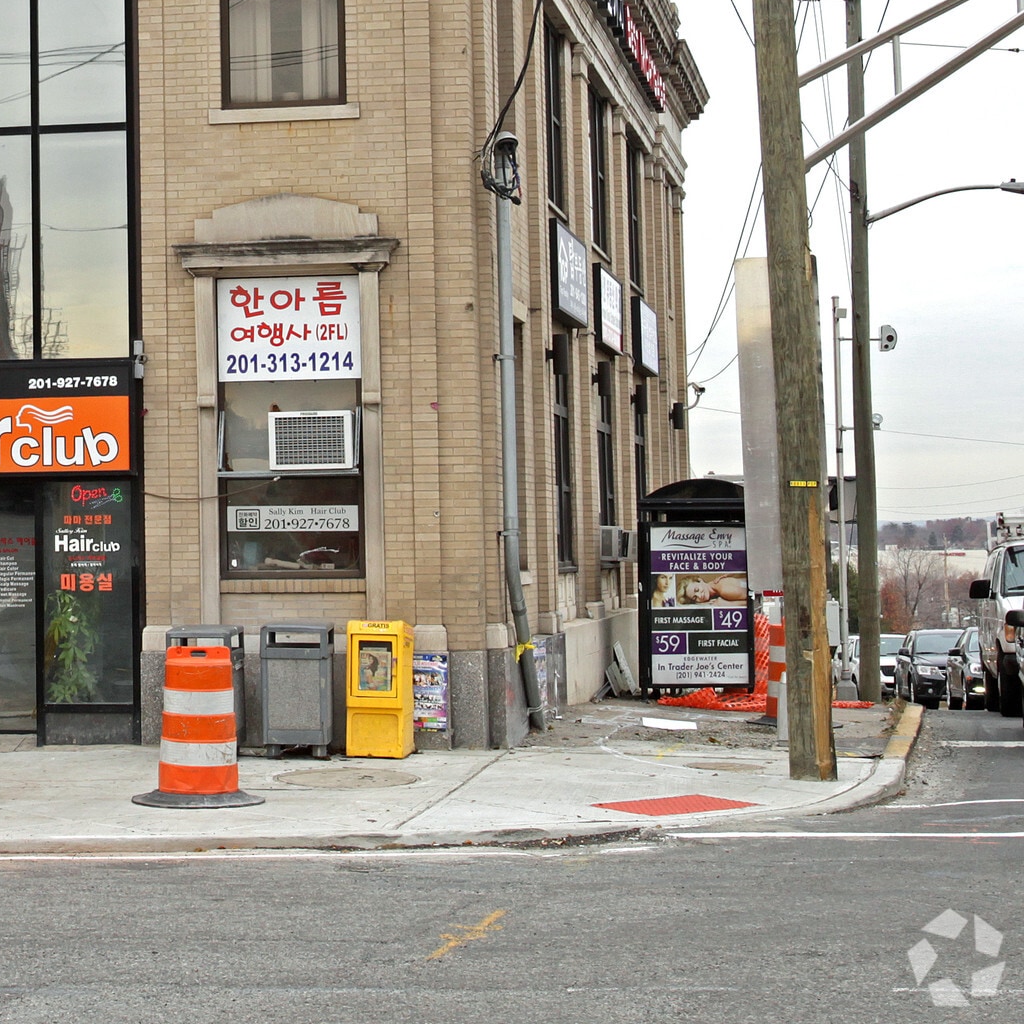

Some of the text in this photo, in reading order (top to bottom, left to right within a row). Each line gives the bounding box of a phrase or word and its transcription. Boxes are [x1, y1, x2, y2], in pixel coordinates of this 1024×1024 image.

[230, 281, 347, 319] 한아름
[230, 322, 348, 347] 여행사 (2FL)
[226, 351, 354, 374] 201-313-1214
[28, 376, 118, 389] 201-927-7678
[71, 484, 107, 507] Open
[269, 507, 347, 516] Sally Kim Hair Club
[239, 518, 258, 528] 할인
[661, 528, 733, 544] Massage Envy
[661, 552, 733, 561] REVITALIZE YOUR
[669, 561, 725, 571] FACE & BODY
[60, 573, 113, 592] 미용실
[654, 616, 671, 624] FIRST
[719, 610, 743, 628] $49
[655, 634, 681, 653] $59
[697, 639, 739, 647] FIRST FACIAL
[657, 662, 743, 671] In Trader Joe's Center
[676, 671, 693, 680] (201)
[694, 671, 726, 679] 941-2424
